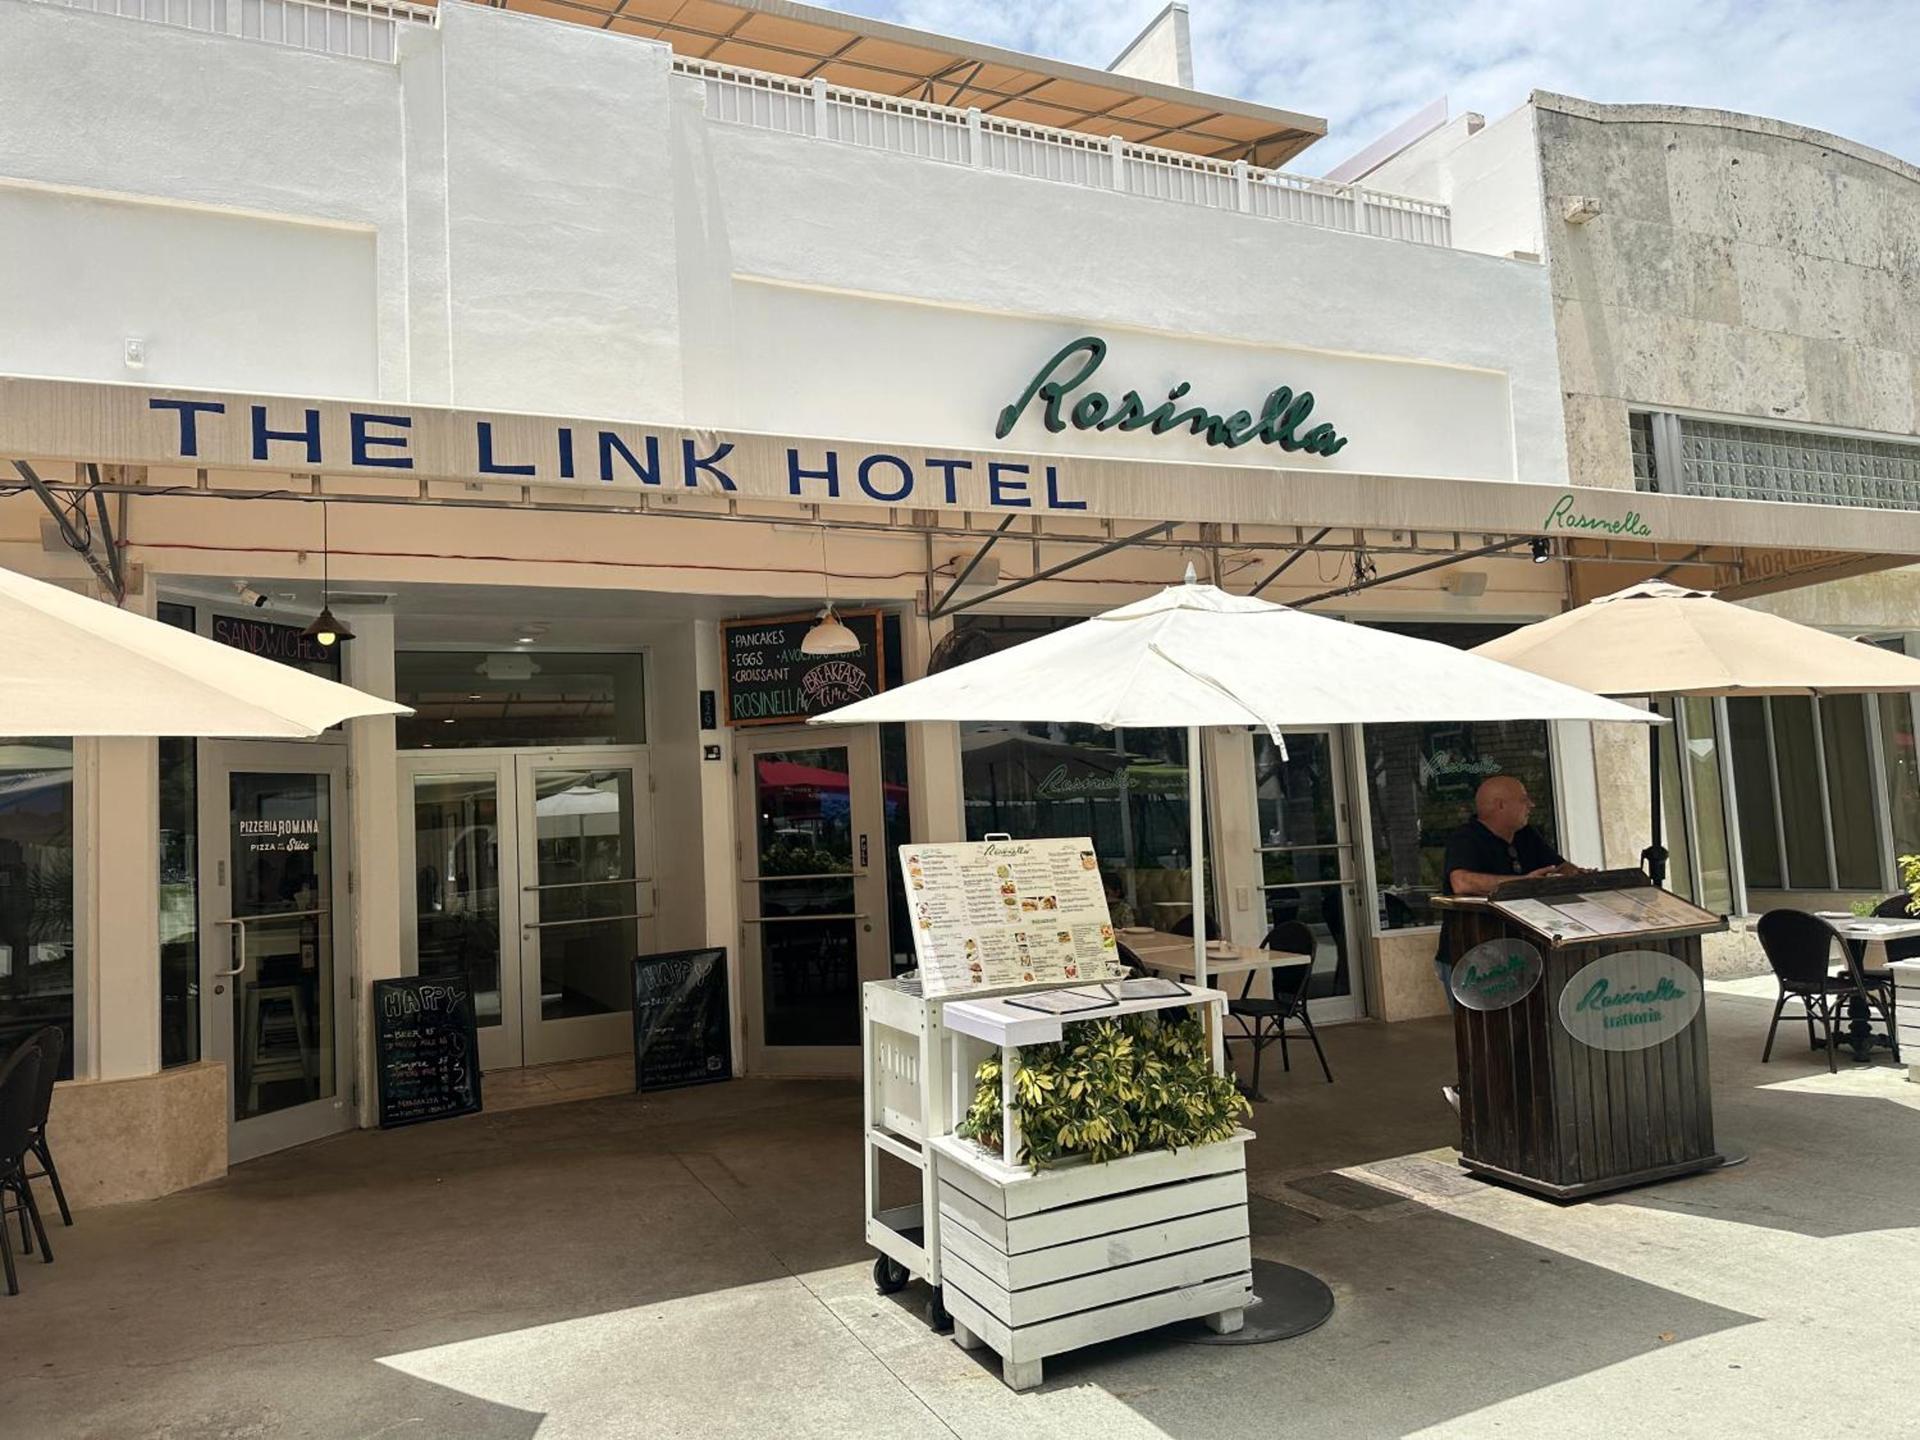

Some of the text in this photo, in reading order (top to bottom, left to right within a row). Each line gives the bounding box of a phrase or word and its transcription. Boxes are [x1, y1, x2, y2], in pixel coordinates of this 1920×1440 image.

[996, 337, 1348, 457] Rosinella
[149, 398, 1088, 511] THE LINK HOTEL
[1544, 494, 1653, 537] Rosinella
[735, 630, 786, 648] PANCAKES
[736, 651, 764, 666] EGGS
[735, 667, 790, 683] CROISSANT
[805, 662, 865, 691] BREAKFAST
[734, 688, 807, 719] ROSINELLA
[240, 819, 320, 837] PIZZERIA ROMANA
[250, 843, 276, 852] PIZZA
[384, 985, 467, 1018] HAPPY
[1576, 977, 1687, 1012] Rosinella
